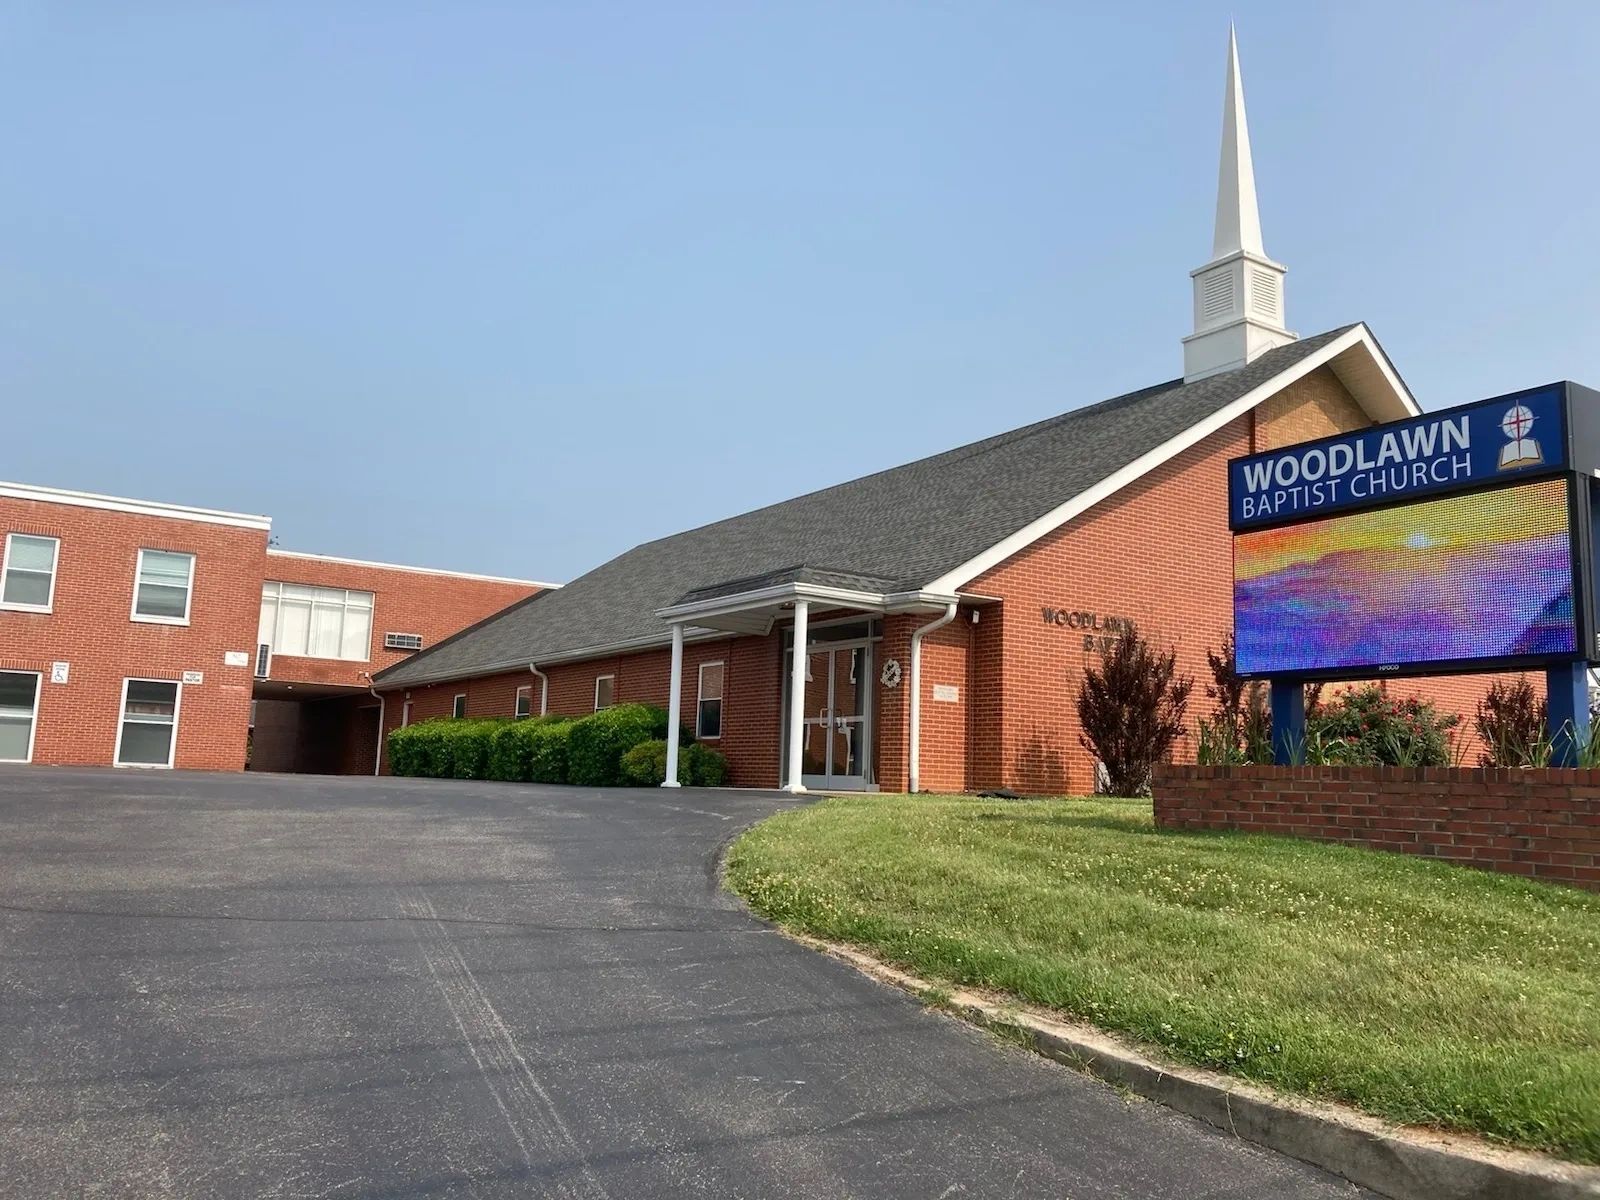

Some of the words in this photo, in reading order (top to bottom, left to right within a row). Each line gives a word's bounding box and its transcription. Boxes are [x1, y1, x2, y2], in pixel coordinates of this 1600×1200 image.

[1242, 479, 1342, 519] BAPTIST
[1350, 453, 1472, 498] CHURCH
[1243, 416, 1471, 493] WOODLAWN
